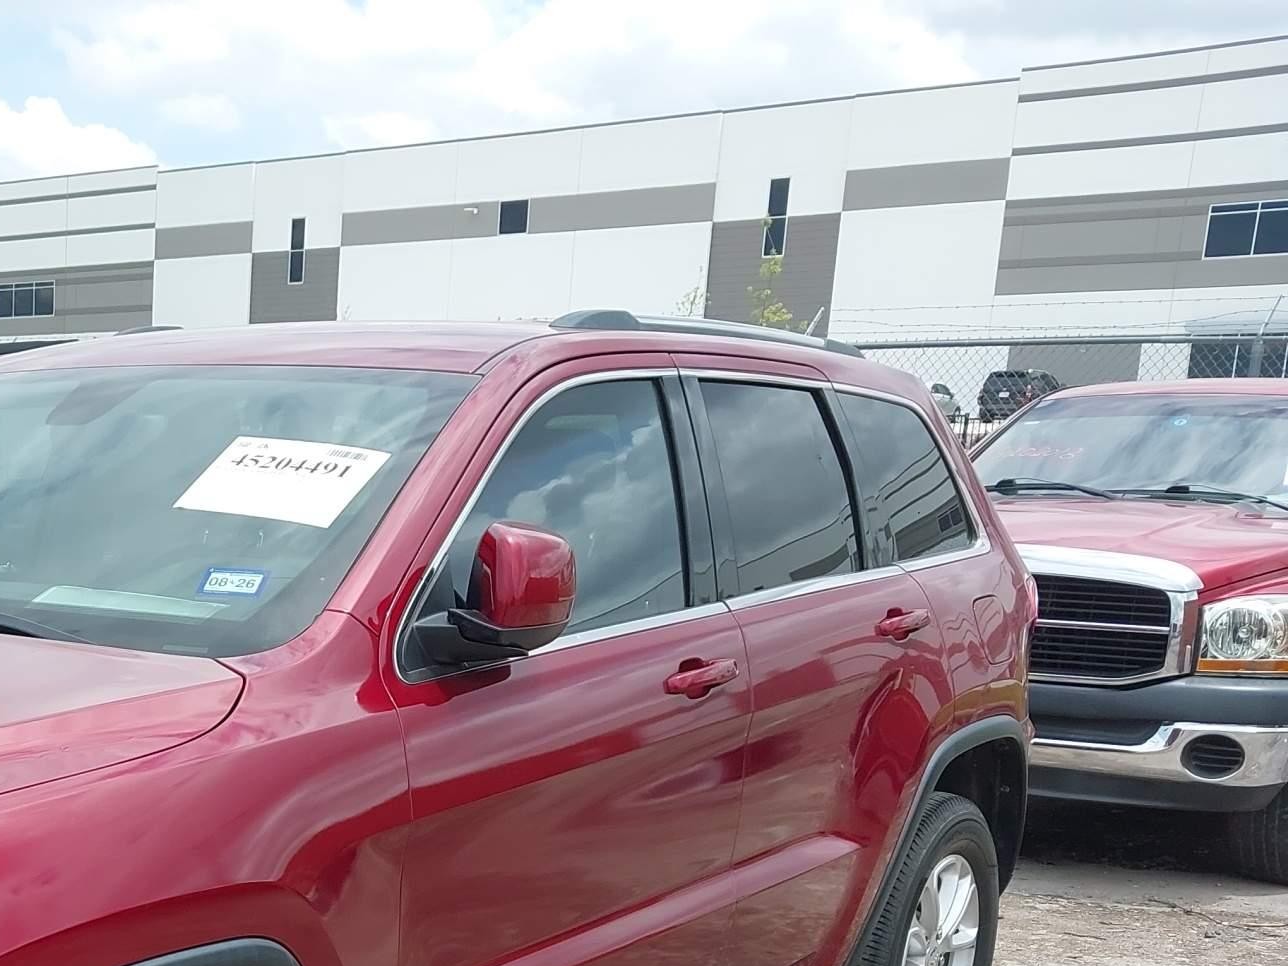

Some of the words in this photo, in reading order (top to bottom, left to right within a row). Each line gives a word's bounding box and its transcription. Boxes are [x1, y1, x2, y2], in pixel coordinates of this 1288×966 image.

[231, 453, 354, 479] 45204491
[208, 576, 229, 587] 08
[235, 578, 257, 589] 26
